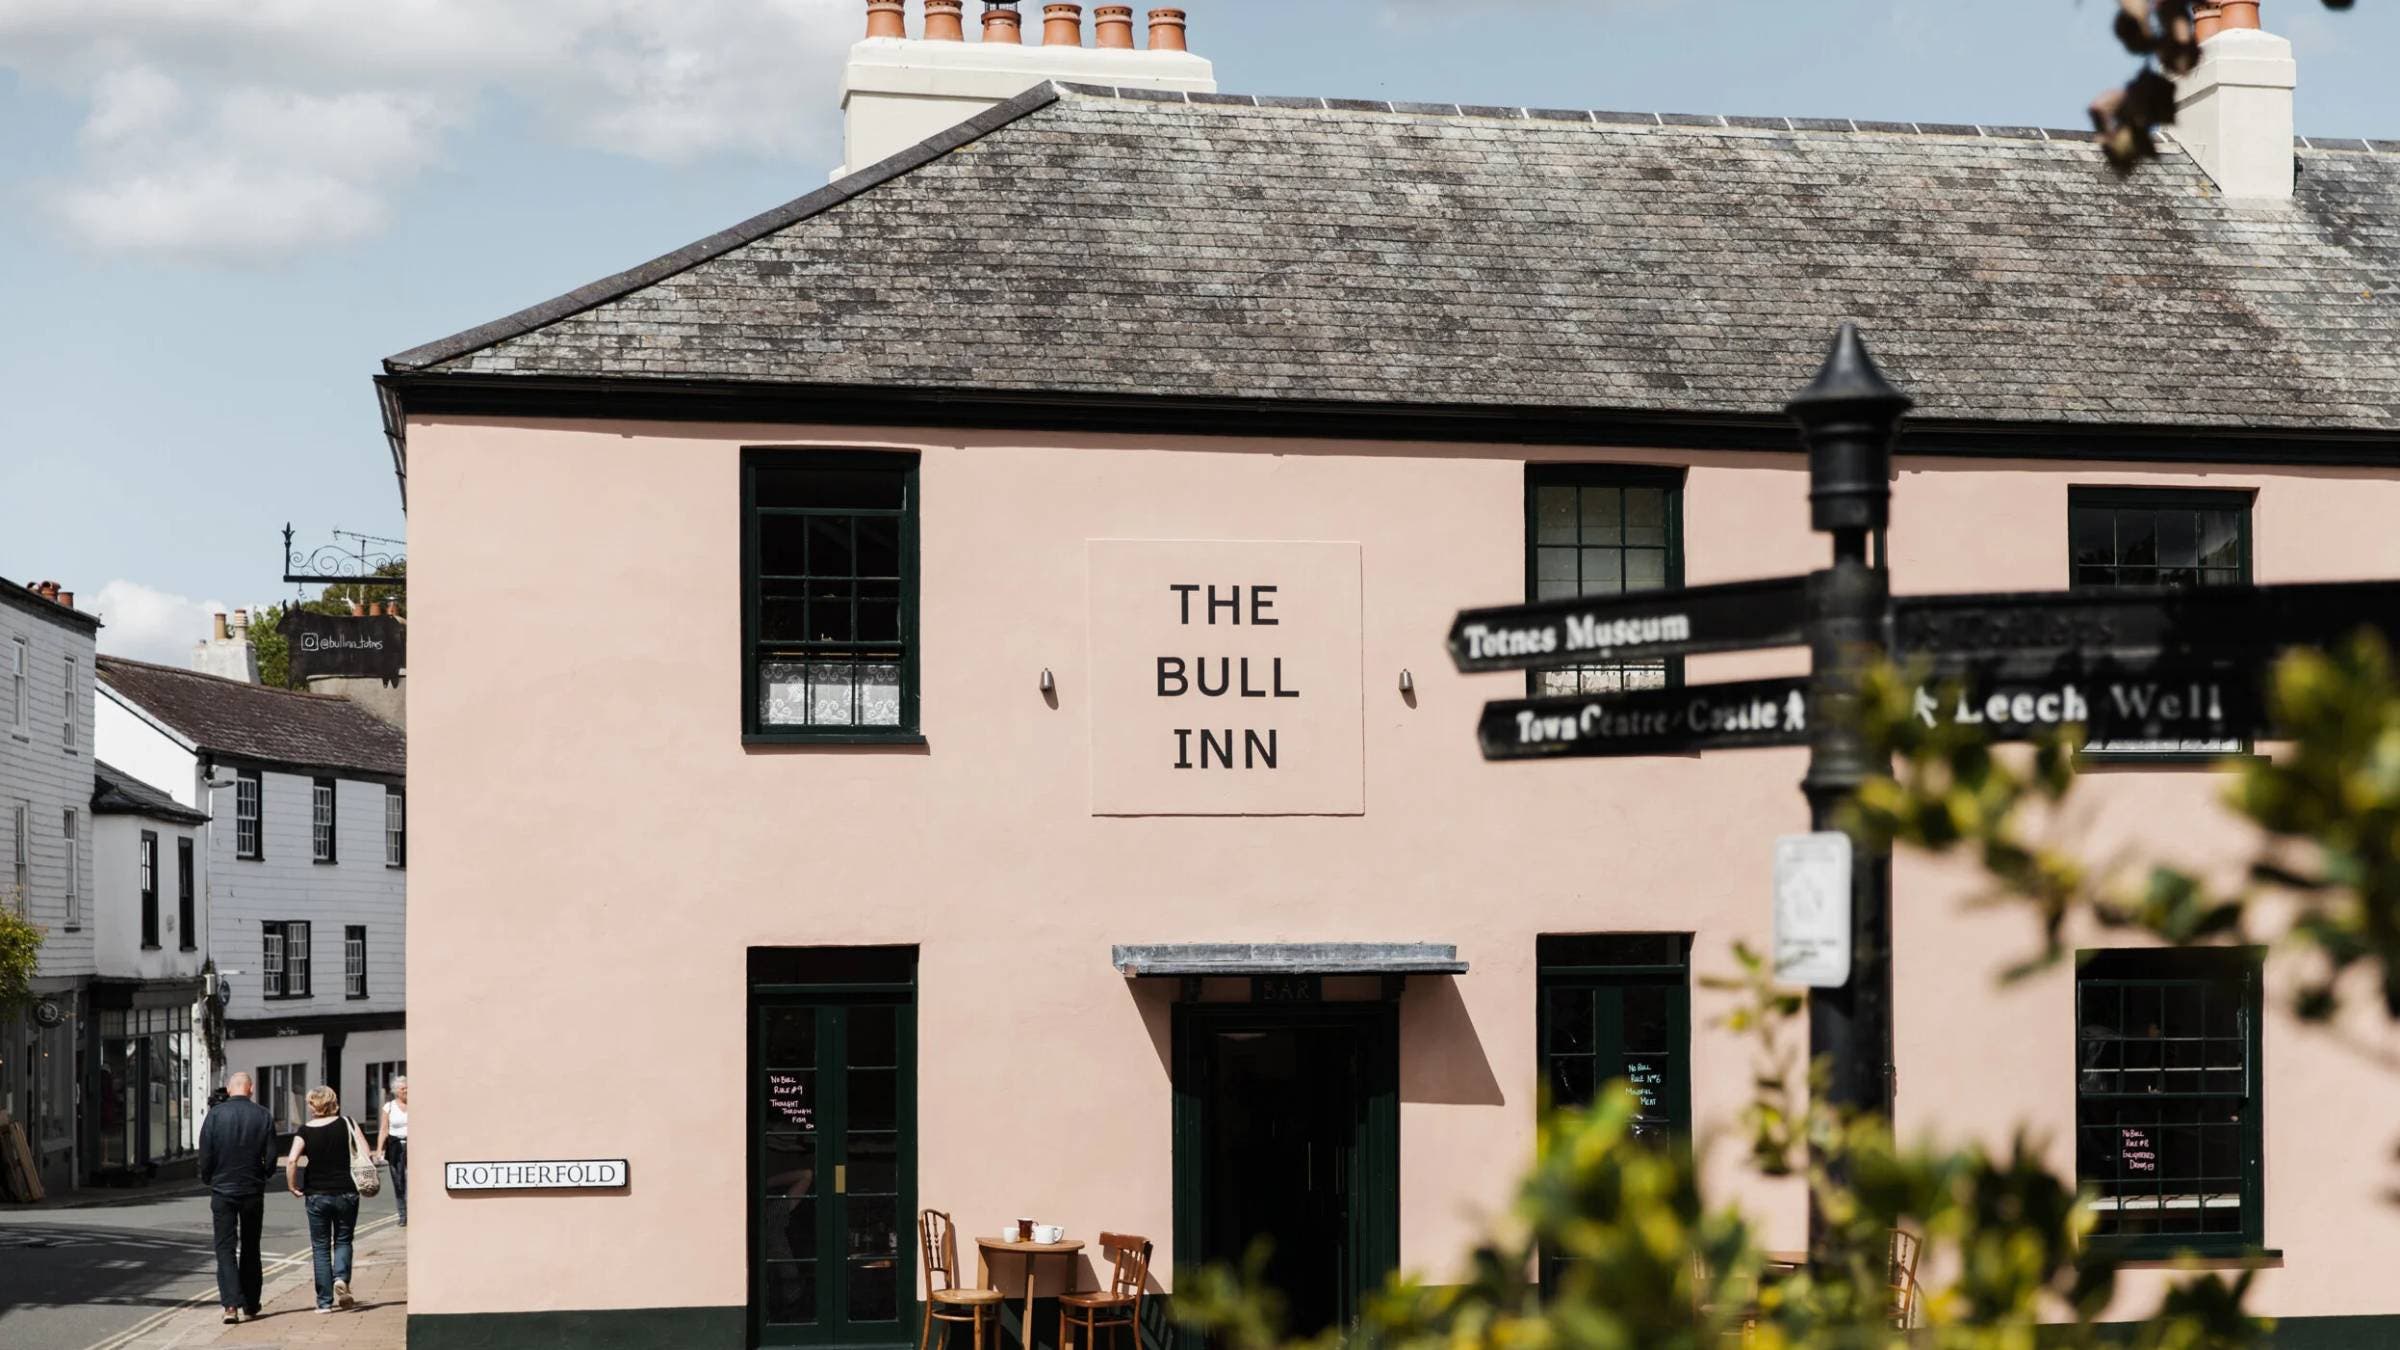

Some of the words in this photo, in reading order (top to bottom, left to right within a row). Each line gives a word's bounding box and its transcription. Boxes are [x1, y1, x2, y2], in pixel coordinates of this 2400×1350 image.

[1170, 584, 1279, 625] THE
[1463, 624, 1556, 659] Totnes
[1565, 614, 1690, 650] Museum
[1157, 656, 1300, 697] BULL
[1516, 710, 1577, 743] Town
[1579, 703, 1668, 736] Centre
[1687, 698, 1778, 732] Castle
[1955, 684, 2089, 724] Leech
[2110, 684, 2224, 721] Well
[1173, 728, 1277, 769] INN
[1263, 979, 1312, 1000] BAR
[769, 1098, 799, 1108] THOUGHT
[455, 1164, 616, 1185] ROTHERFOLD
